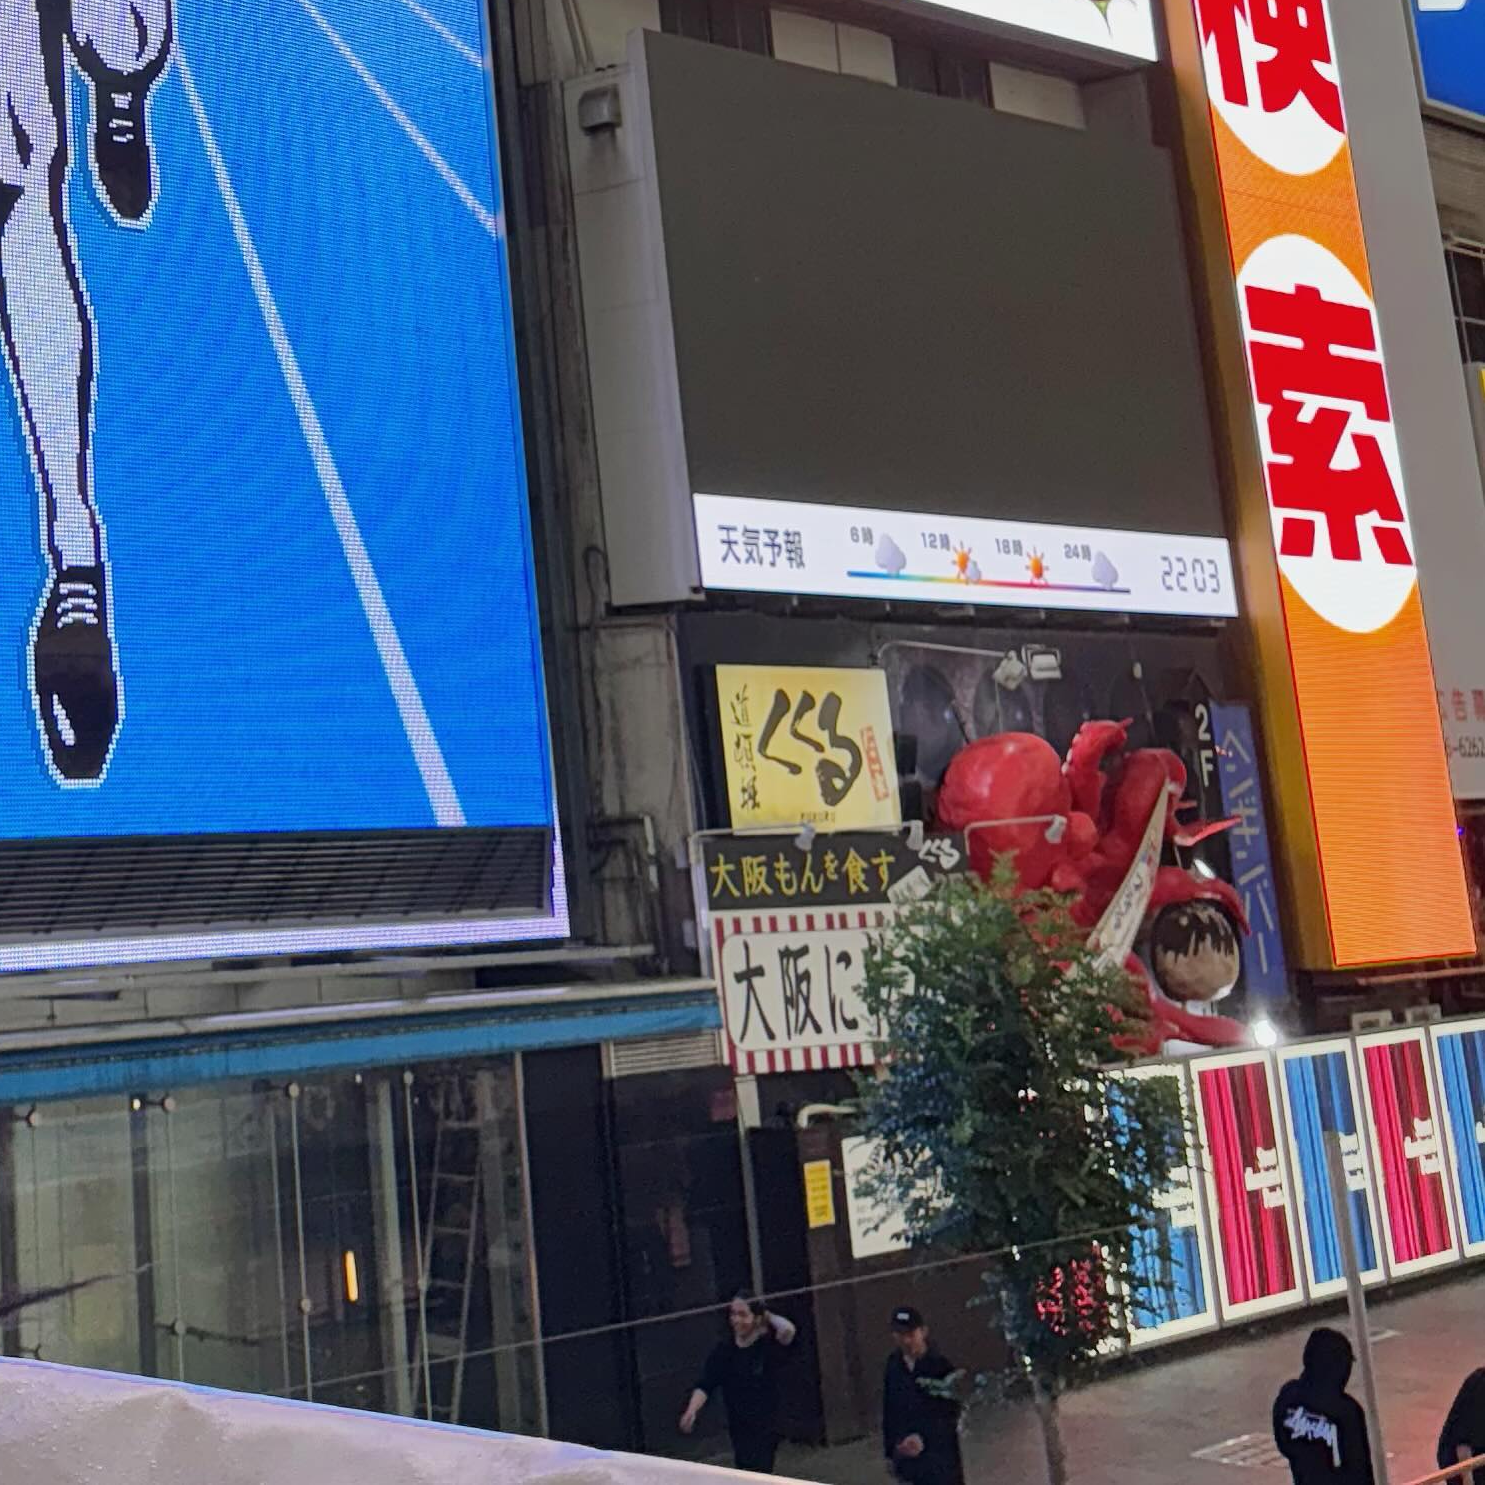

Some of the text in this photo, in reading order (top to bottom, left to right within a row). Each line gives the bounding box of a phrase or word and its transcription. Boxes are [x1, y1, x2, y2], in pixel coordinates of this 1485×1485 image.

[718, 524, 806, 569] 天気予報
[757, 688, 863, 807] くくる
[709, 847, 895, 898] 大阪もんを食す
[733, 931, 887, 1044] 大阪に
